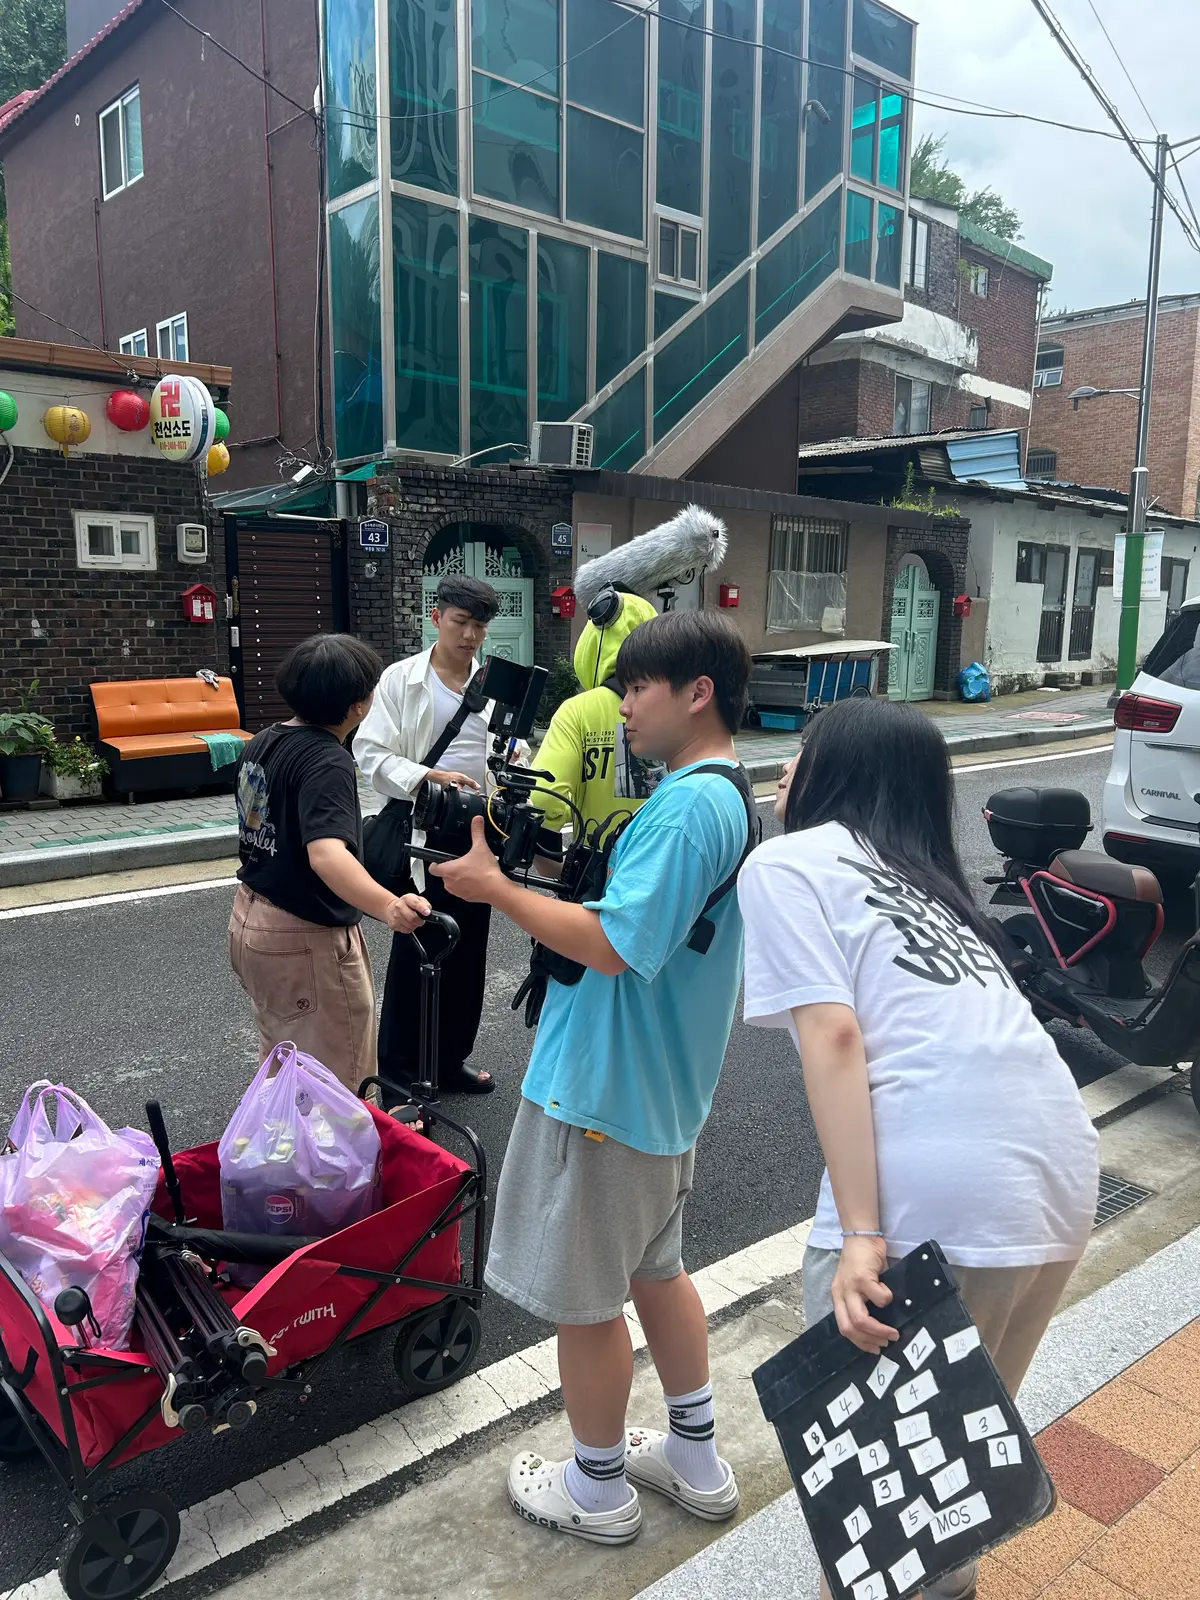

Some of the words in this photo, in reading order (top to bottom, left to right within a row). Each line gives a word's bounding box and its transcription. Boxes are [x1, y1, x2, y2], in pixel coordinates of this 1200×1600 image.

[154, 420, 191, 438] 천신소도
[368, 533, 381, 543] 43
[557, 534, 567, 544] 45
[1140, 787, 1181, 801] CARNIVAL
[266, 1203, 292, 1214] PEPSI
[911, 1343, 927, 1360] 2
[876, 1367, 885, 1386] 6
[909, 1383, 918, 1400] 4
[839, 1397, 852, 1415] 4
[979, 1416, 988, 1433] 3
[811, 1431, 820, 1445] 8
[835, 1443, 847, 1456] 2
[869, 1448, 879, 1467] 9
[996, 1441, 1009, 1466] 9
[811, 1471, 824, 1488] 1
[879, 1479, 891, 1499] 3
[513, 1500, 559, 1530] crocs
[908, 1510, 919, 1526] 5
[936, 1505, 971, 1535] MOS
[851, 1515, 861, 1536] 7
[902, 1561, 912, 1581] 6
